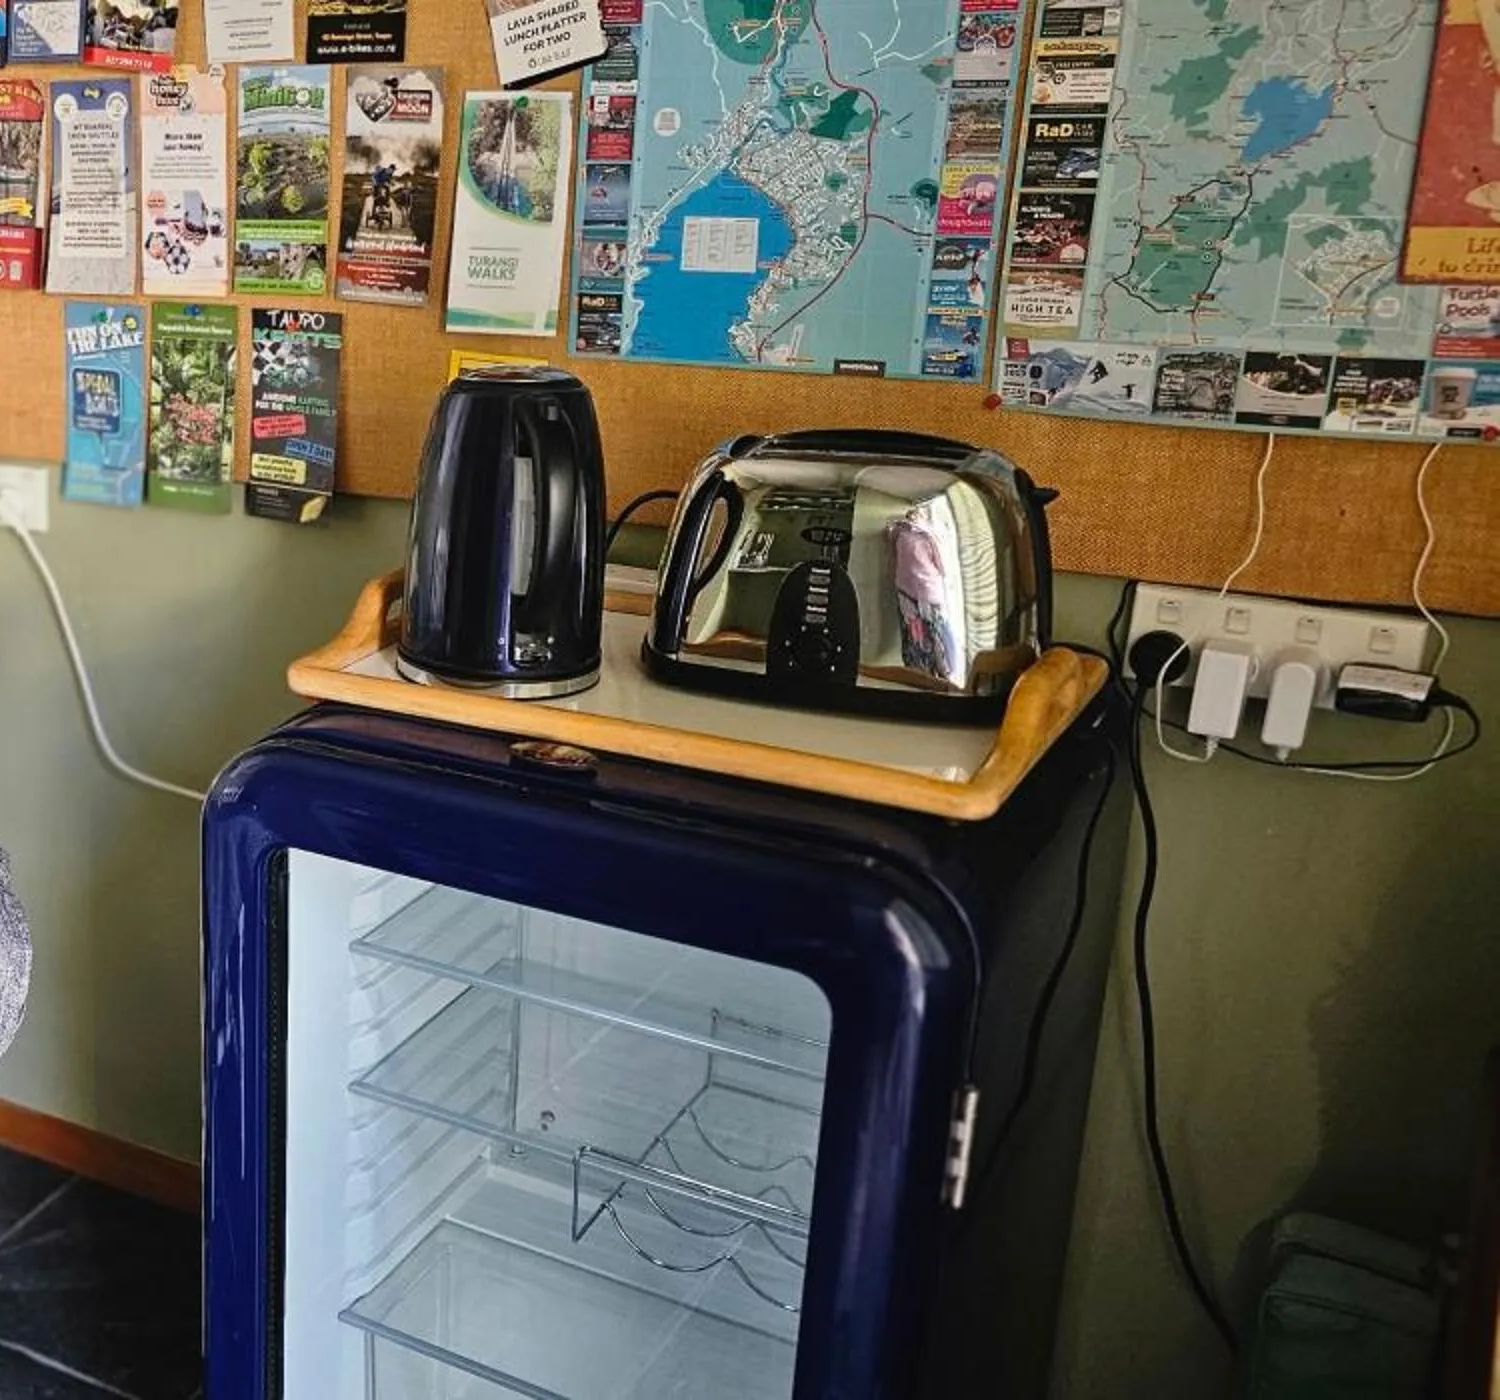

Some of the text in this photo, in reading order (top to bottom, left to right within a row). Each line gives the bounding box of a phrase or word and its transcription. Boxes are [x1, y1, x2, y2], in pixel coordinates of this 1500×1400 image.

[507, 0, 579, 31] LAVA SHARED
[503, 11, 587, 46] LUNCH PLATTER
[524, 31, 571, 54] FOR TWO
[1035, 123, 1074, 137] RaD
[468, 256, 519, 268] TURANGI
[468, 267, 516, 281] WALKS
[1011, 303, 1074, 315] HIGH TEA
[266, 310, 325, 330] TAUPO
[99, 331, 144, 350] LAKE
